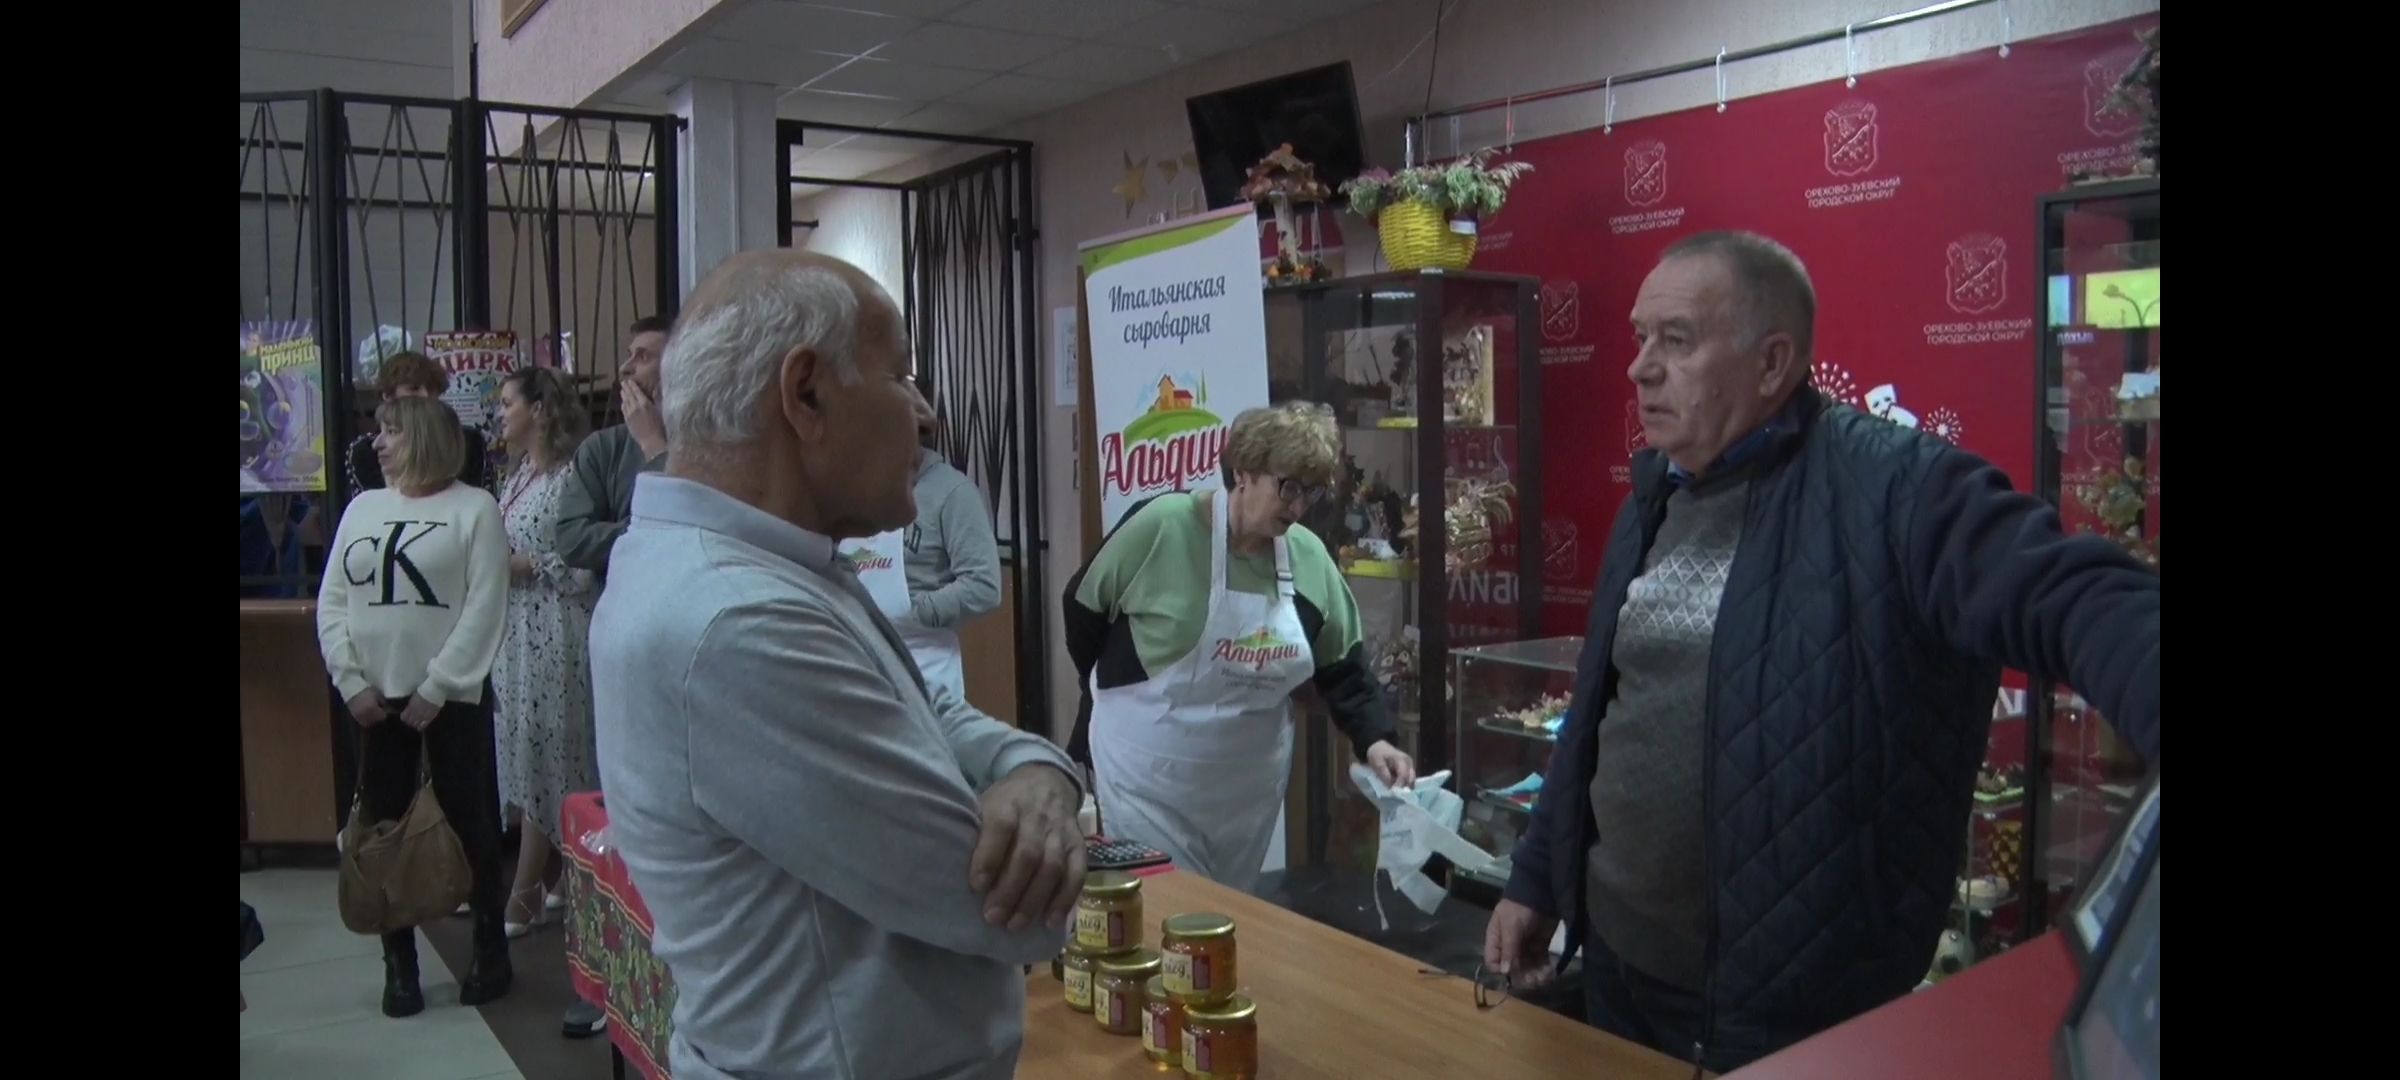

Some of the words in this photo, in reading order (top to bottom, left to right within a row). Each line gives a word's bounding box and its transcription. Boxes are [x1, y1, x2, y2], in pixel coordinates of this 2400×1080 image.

[1804, 176, 1901, 199] ОРЕХОВО-ЗУЕВСКИЙ
[1808, 193, 1864, 209] ГОРОДСКОЙ
[1865, 188, 1895, 202] ОКРУГ
[1108, 275, 1226, 313] Итальянская
[1122, 310, 1212, 349] сыроварня
[1923, 317, 2032, 335] ОРЕХОВО-ЗУЕВСКИЙ
[1926, 330, 1990, 345] ГОРОДСКОЙ
[1991, 329, 2026, 342] ОКРУГ
[261, 343, 316, 375] ПРИНЦ
[1102, 424, 1231, 500] Альдин
[1211, 637, 1300, 671] Альдини
